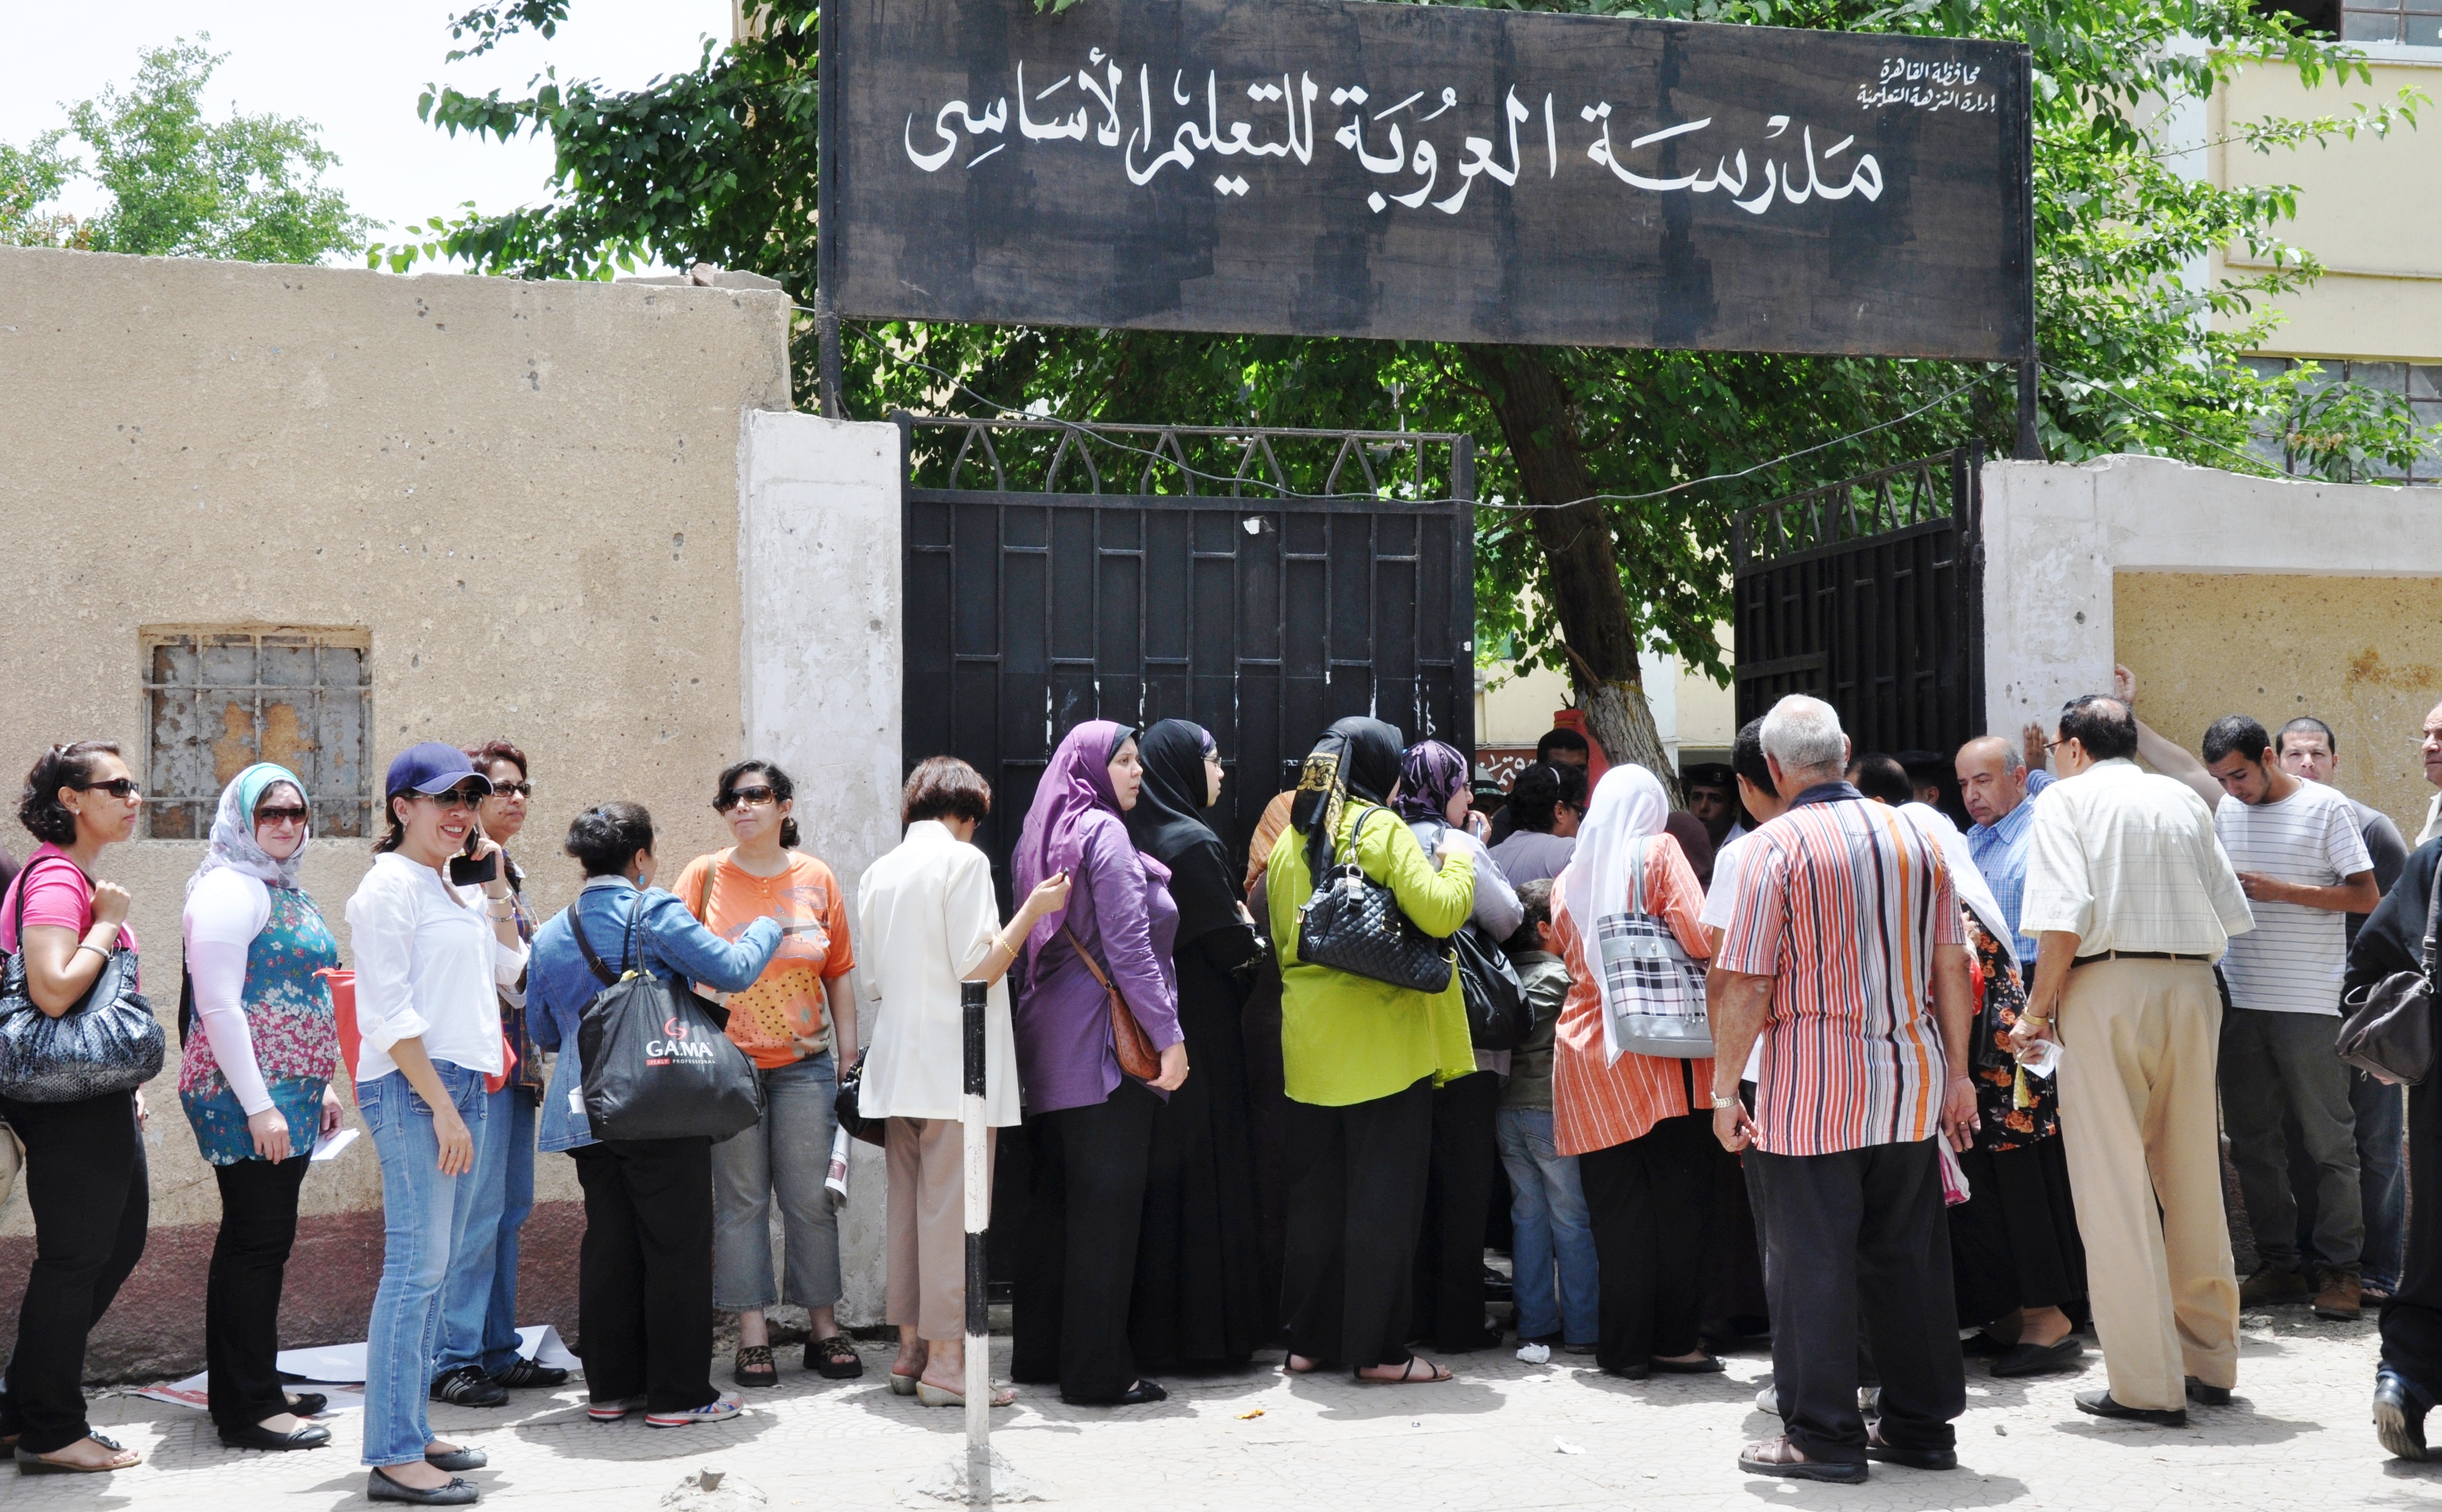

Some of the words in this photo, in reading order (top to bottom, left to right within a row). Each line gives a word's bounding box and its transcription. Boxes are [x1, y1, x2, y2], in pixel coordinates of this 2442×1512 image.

[1879, 58, 1929, 84] القاهرة
[1931, 62, 1981, 86] محافظة
[1910, 86, 1960, 112] النزهة
